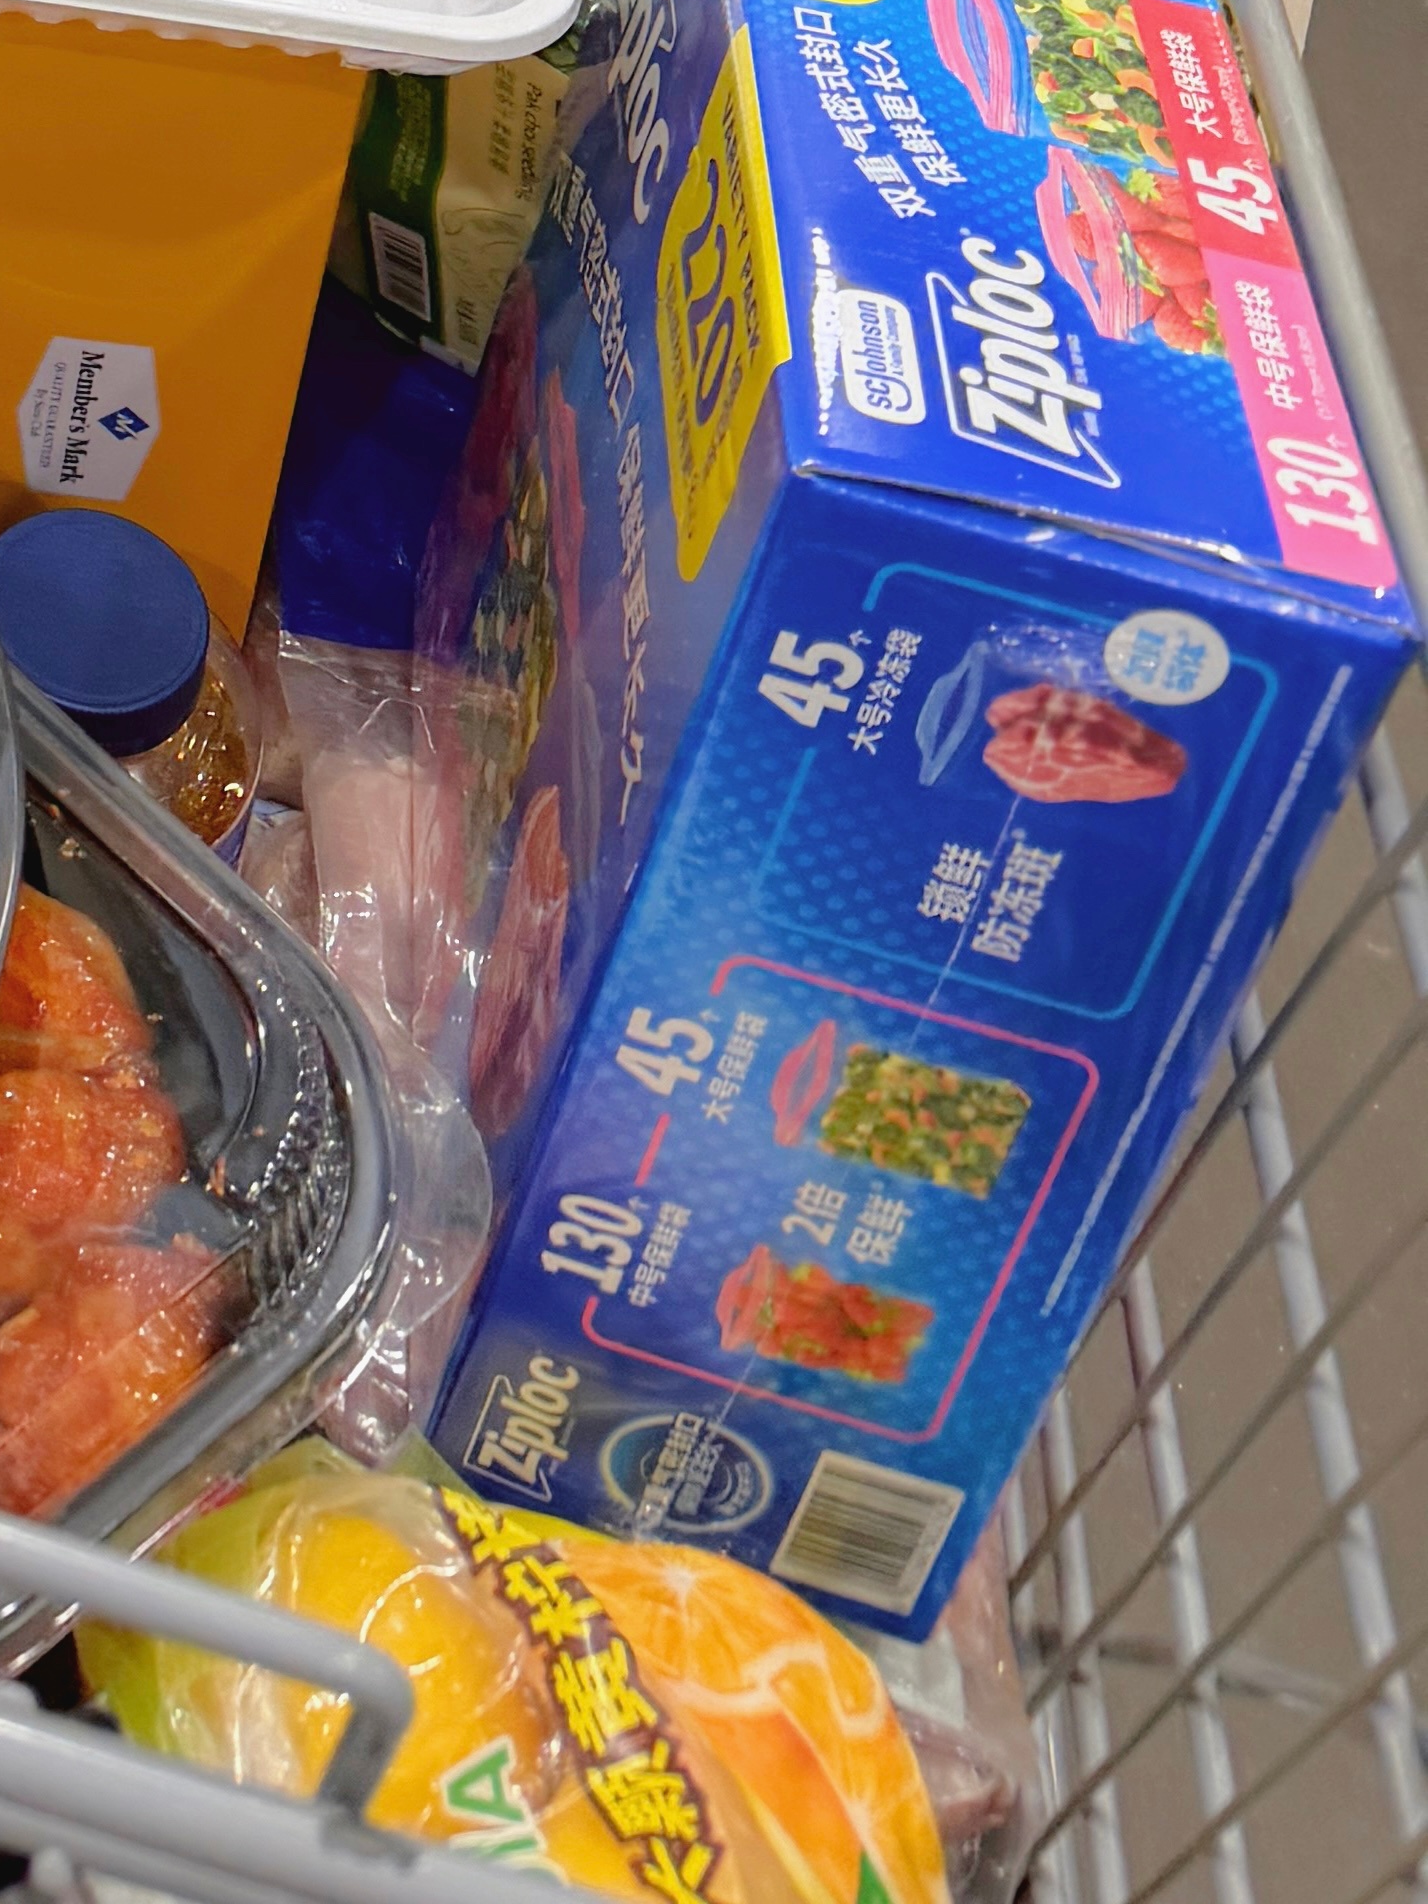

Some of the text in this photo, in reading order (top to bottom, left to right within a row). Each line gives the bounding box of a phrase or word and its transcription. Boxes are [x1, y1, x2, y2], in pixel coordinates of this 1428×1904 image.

[793, 5, 940, 221] 双重气密式封口
[872, 36, 969, 188] 保鲜更长久
[1170, 29, 1223, 140] 大号保鲜袋
[682, 156, 736, 430] 220
[964, 236, 1103, 460] Ziploc
[1245, 279, 1300, 411] 中号保鲜袋
[58, 349, 106, 484] Member's Mark
[848, 628, 924, 756] 大号冷冻袋
[915, 841, 990, 927] 锁鲜
[970, 837, 1064, 964] 防冻斑
[700, 1009, 772, 1126] 大号保鲜袋
[626, 1200, 694, 1311] 中号保鲜袋
[781, 1178, 851, 1248] 2倍
[844, 1190, 915, 1266] 保鲜
[482, 1355, 582, 1486] Ziploc
